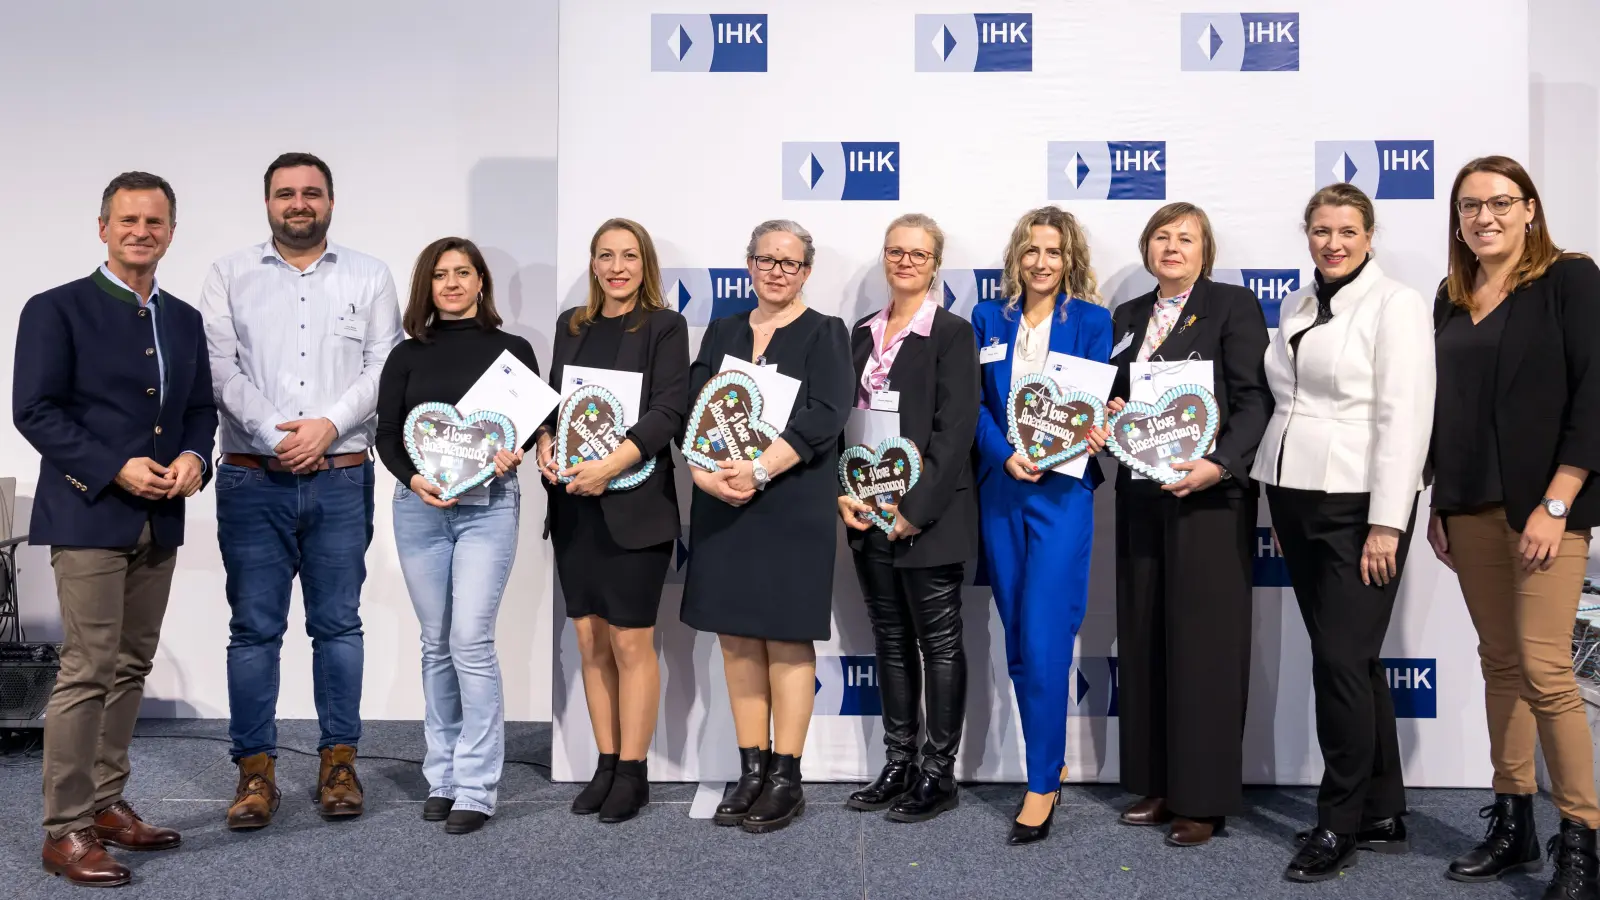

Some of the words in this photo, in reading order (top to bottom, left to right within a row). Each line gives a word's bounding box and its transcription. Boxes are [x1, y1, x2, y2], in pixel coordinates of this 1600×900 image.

[718, 23, 763, 43] IHK
[982, 23, 1028, 43] IHK
[1248, 22, 1295, 43] IHK
[849, 152, 895, 172] IHK
[1115, 151, 1162, 171] IHK
[1383, 150, 1430, 170] IHK
[982, 279, 1001, 299] IH
[1250, 279, 1294, 299] IHK
[1049, 404, 1069, 423] love
[1153, 415, 1176, 432] love
[452, 426, 472, 444] love
[571, 414, 610, 459] Anerkenn
[733, 418, 750, 442] love
[1018, 407, 1075, 448] Anerkennung
[1127, 424, 1201, 455] Anerkennung
[420, 436, 489, 469] Anerkennung
[876, 466, 891, 480] love
[857, 479, 906, 500] Anerkennung
[848, 666, 879, 686] IH
[1385, 668, 1432, 689] IHK
